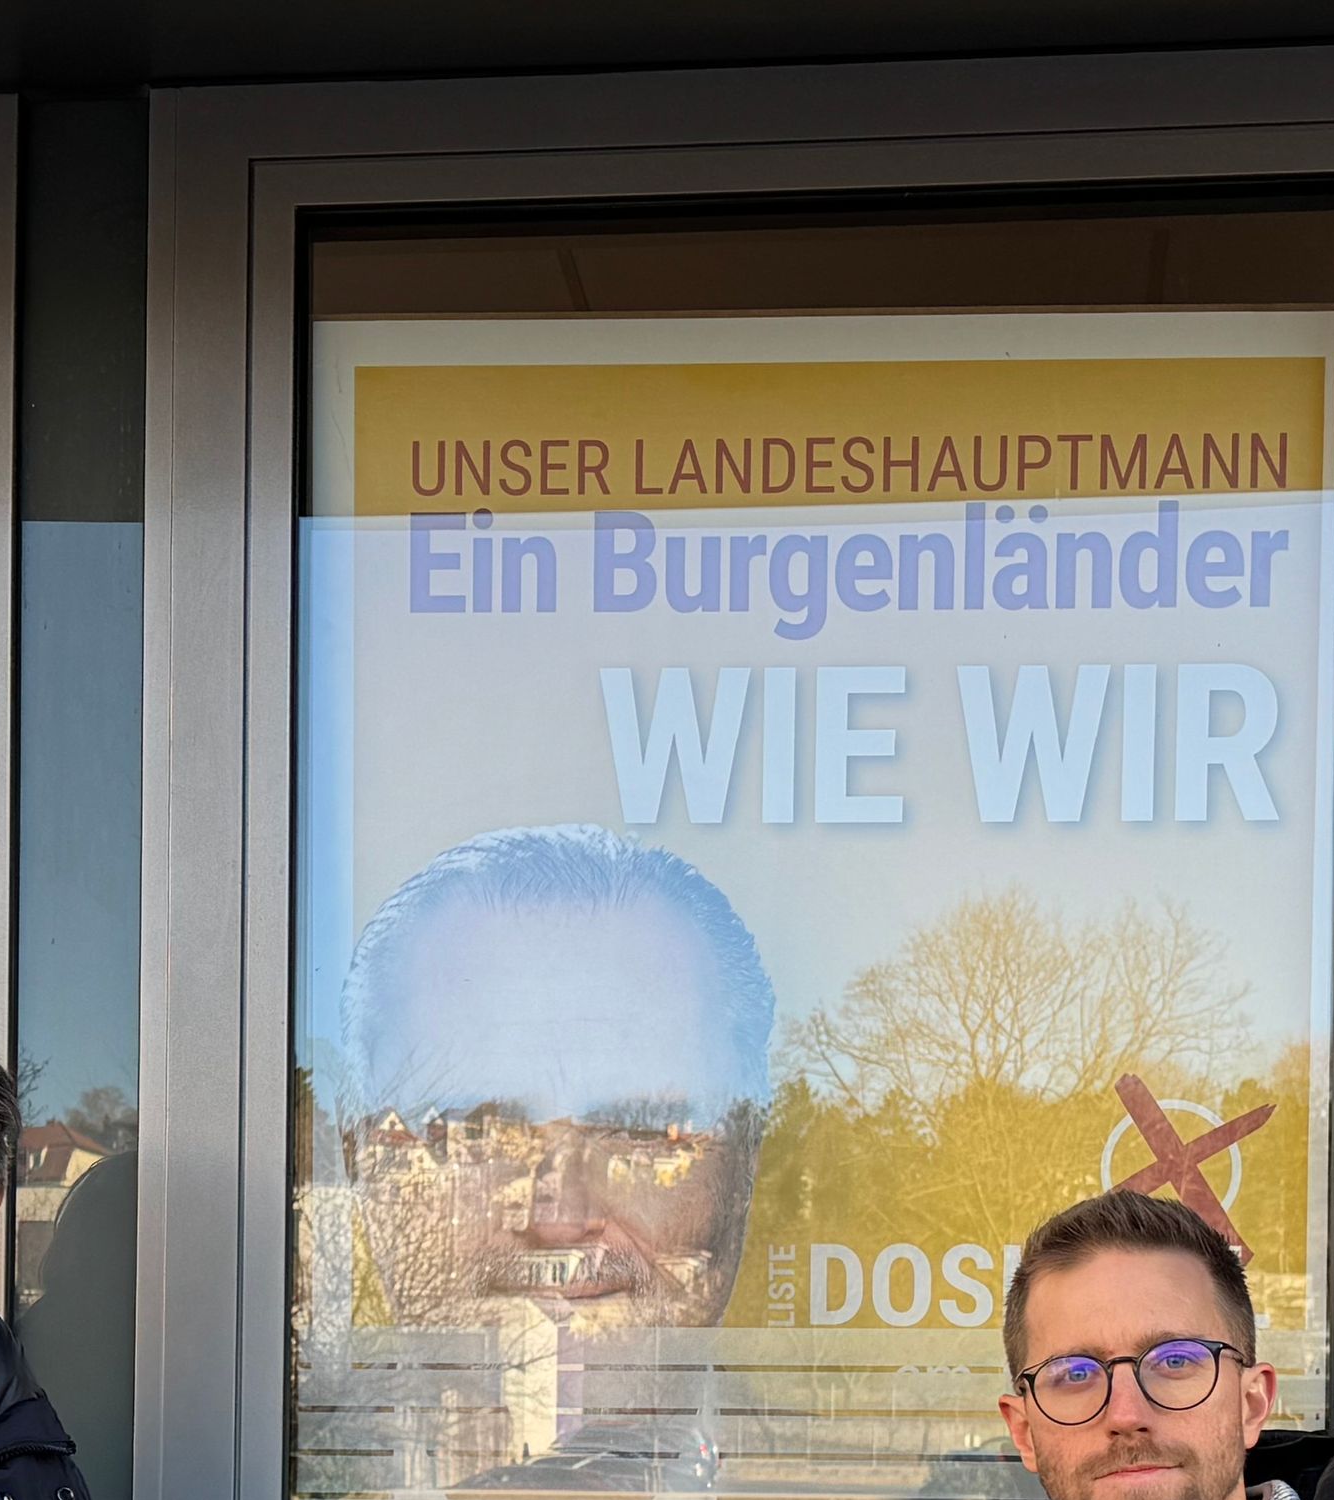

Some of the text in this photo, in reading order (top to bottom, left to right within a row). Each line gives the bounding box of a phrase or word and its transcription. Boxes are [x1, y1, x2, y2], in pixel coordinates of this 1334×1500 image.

[410, 432, 1290, 497] UNSER LANDESHAUPTMANN
[409, 499, 1289, 641] Ein Burgenländer
[599, 662, 1282, 826] WIE WIR
[767, 1243, 797, 1328] LISTE
